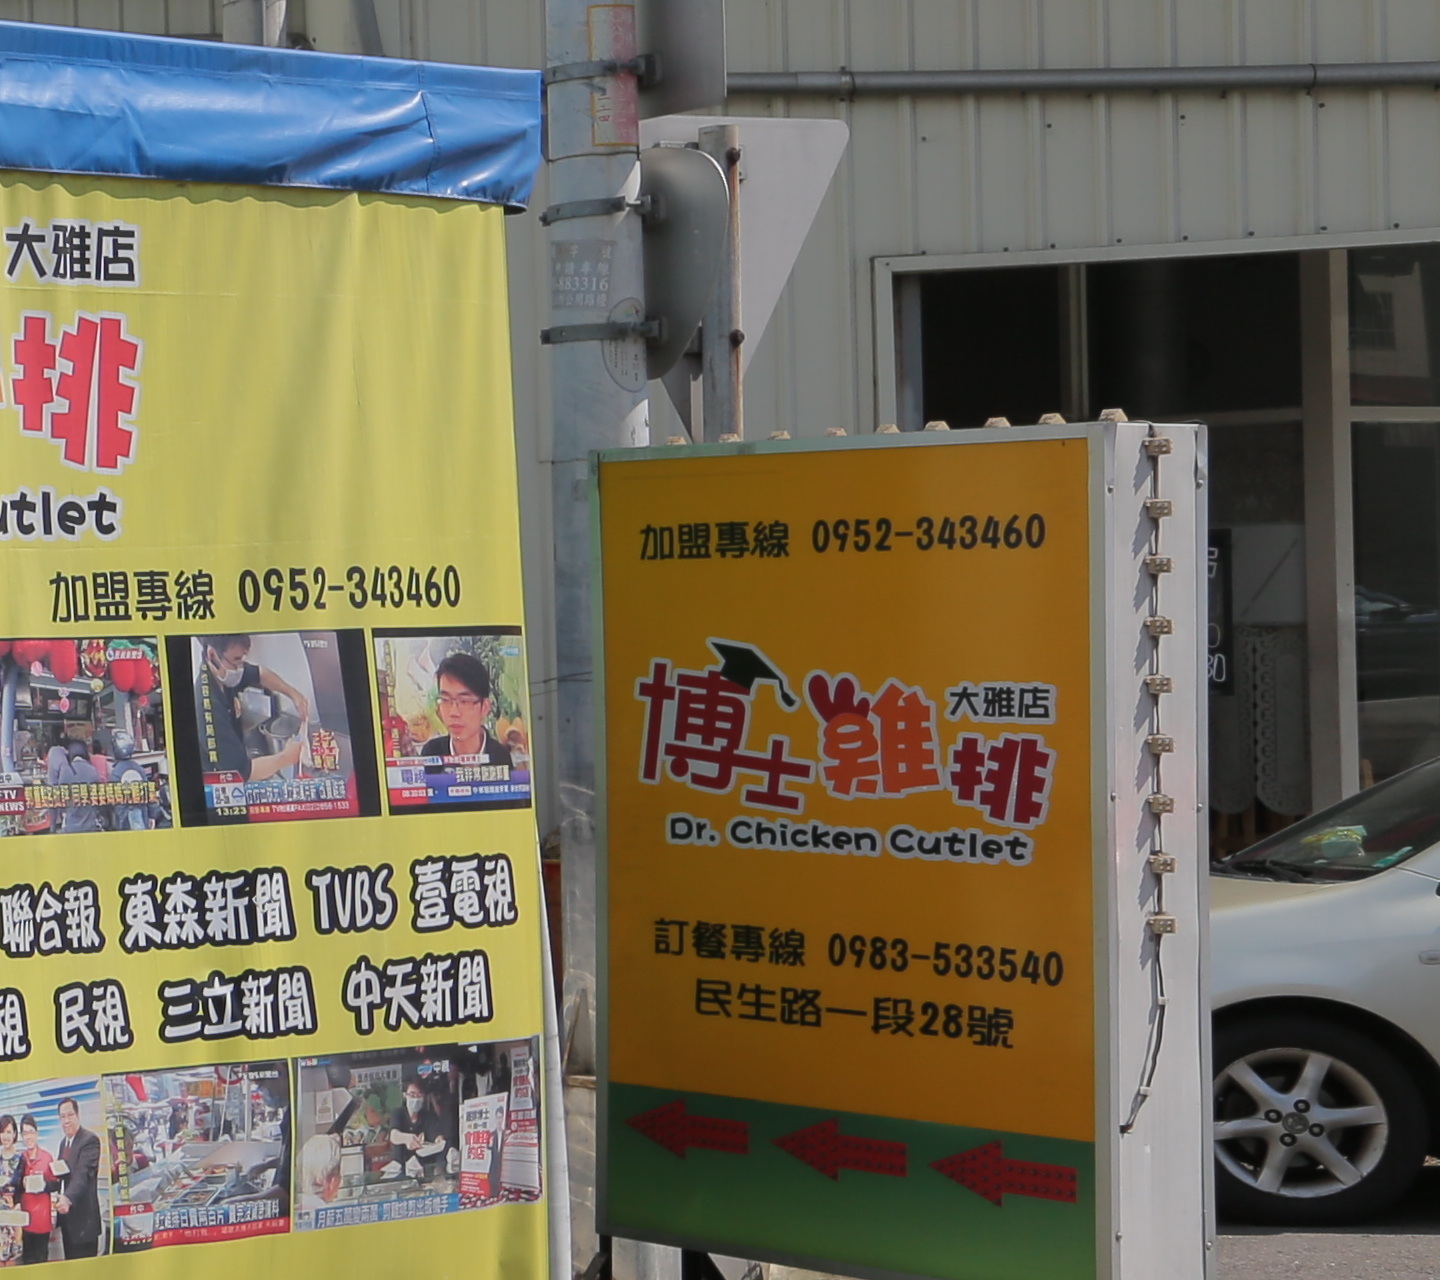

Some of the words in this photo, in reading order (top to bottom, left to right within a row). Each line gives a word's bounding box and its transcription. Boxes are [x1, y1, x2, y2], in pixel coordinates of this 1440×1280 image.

[4, 223, 138, 285] 大雅店
[639, 521, 791, 563] 加盟專線
[811, 513, 1047, 554] 0952-343460
[49, 569, 219, 624] 加盟專線
[236, 562, 463, 616] 0952-343460
[636, 658, 1053, 825] 博士雞排
[947, 682, 1053, 722] 大雅店
[217, 806, 247, 817] 13:23
[669, 815, 718, 847] Dr.
[729, 815, 878, 853] Chicken
[887, 826, 1030, 862] Cutlet
[0, 886, 101, 953] 聯合報
[120, 872, 293, 949] 東森新聞
[311, 870, 394, 919] TVBS
[413, 855, 519, 929] 壹電視
[653, 917, 806, 968] 訂餐專線
[827, 933, 1066, 987] 0983-533540
[60, 985, 131, 1050] 民視
[162, 972, 314, 1042] 三立新聞
[346, 955, 491, 1031] 中天新聞
[692, 978, 1016, 1050] 民生路一段28號
